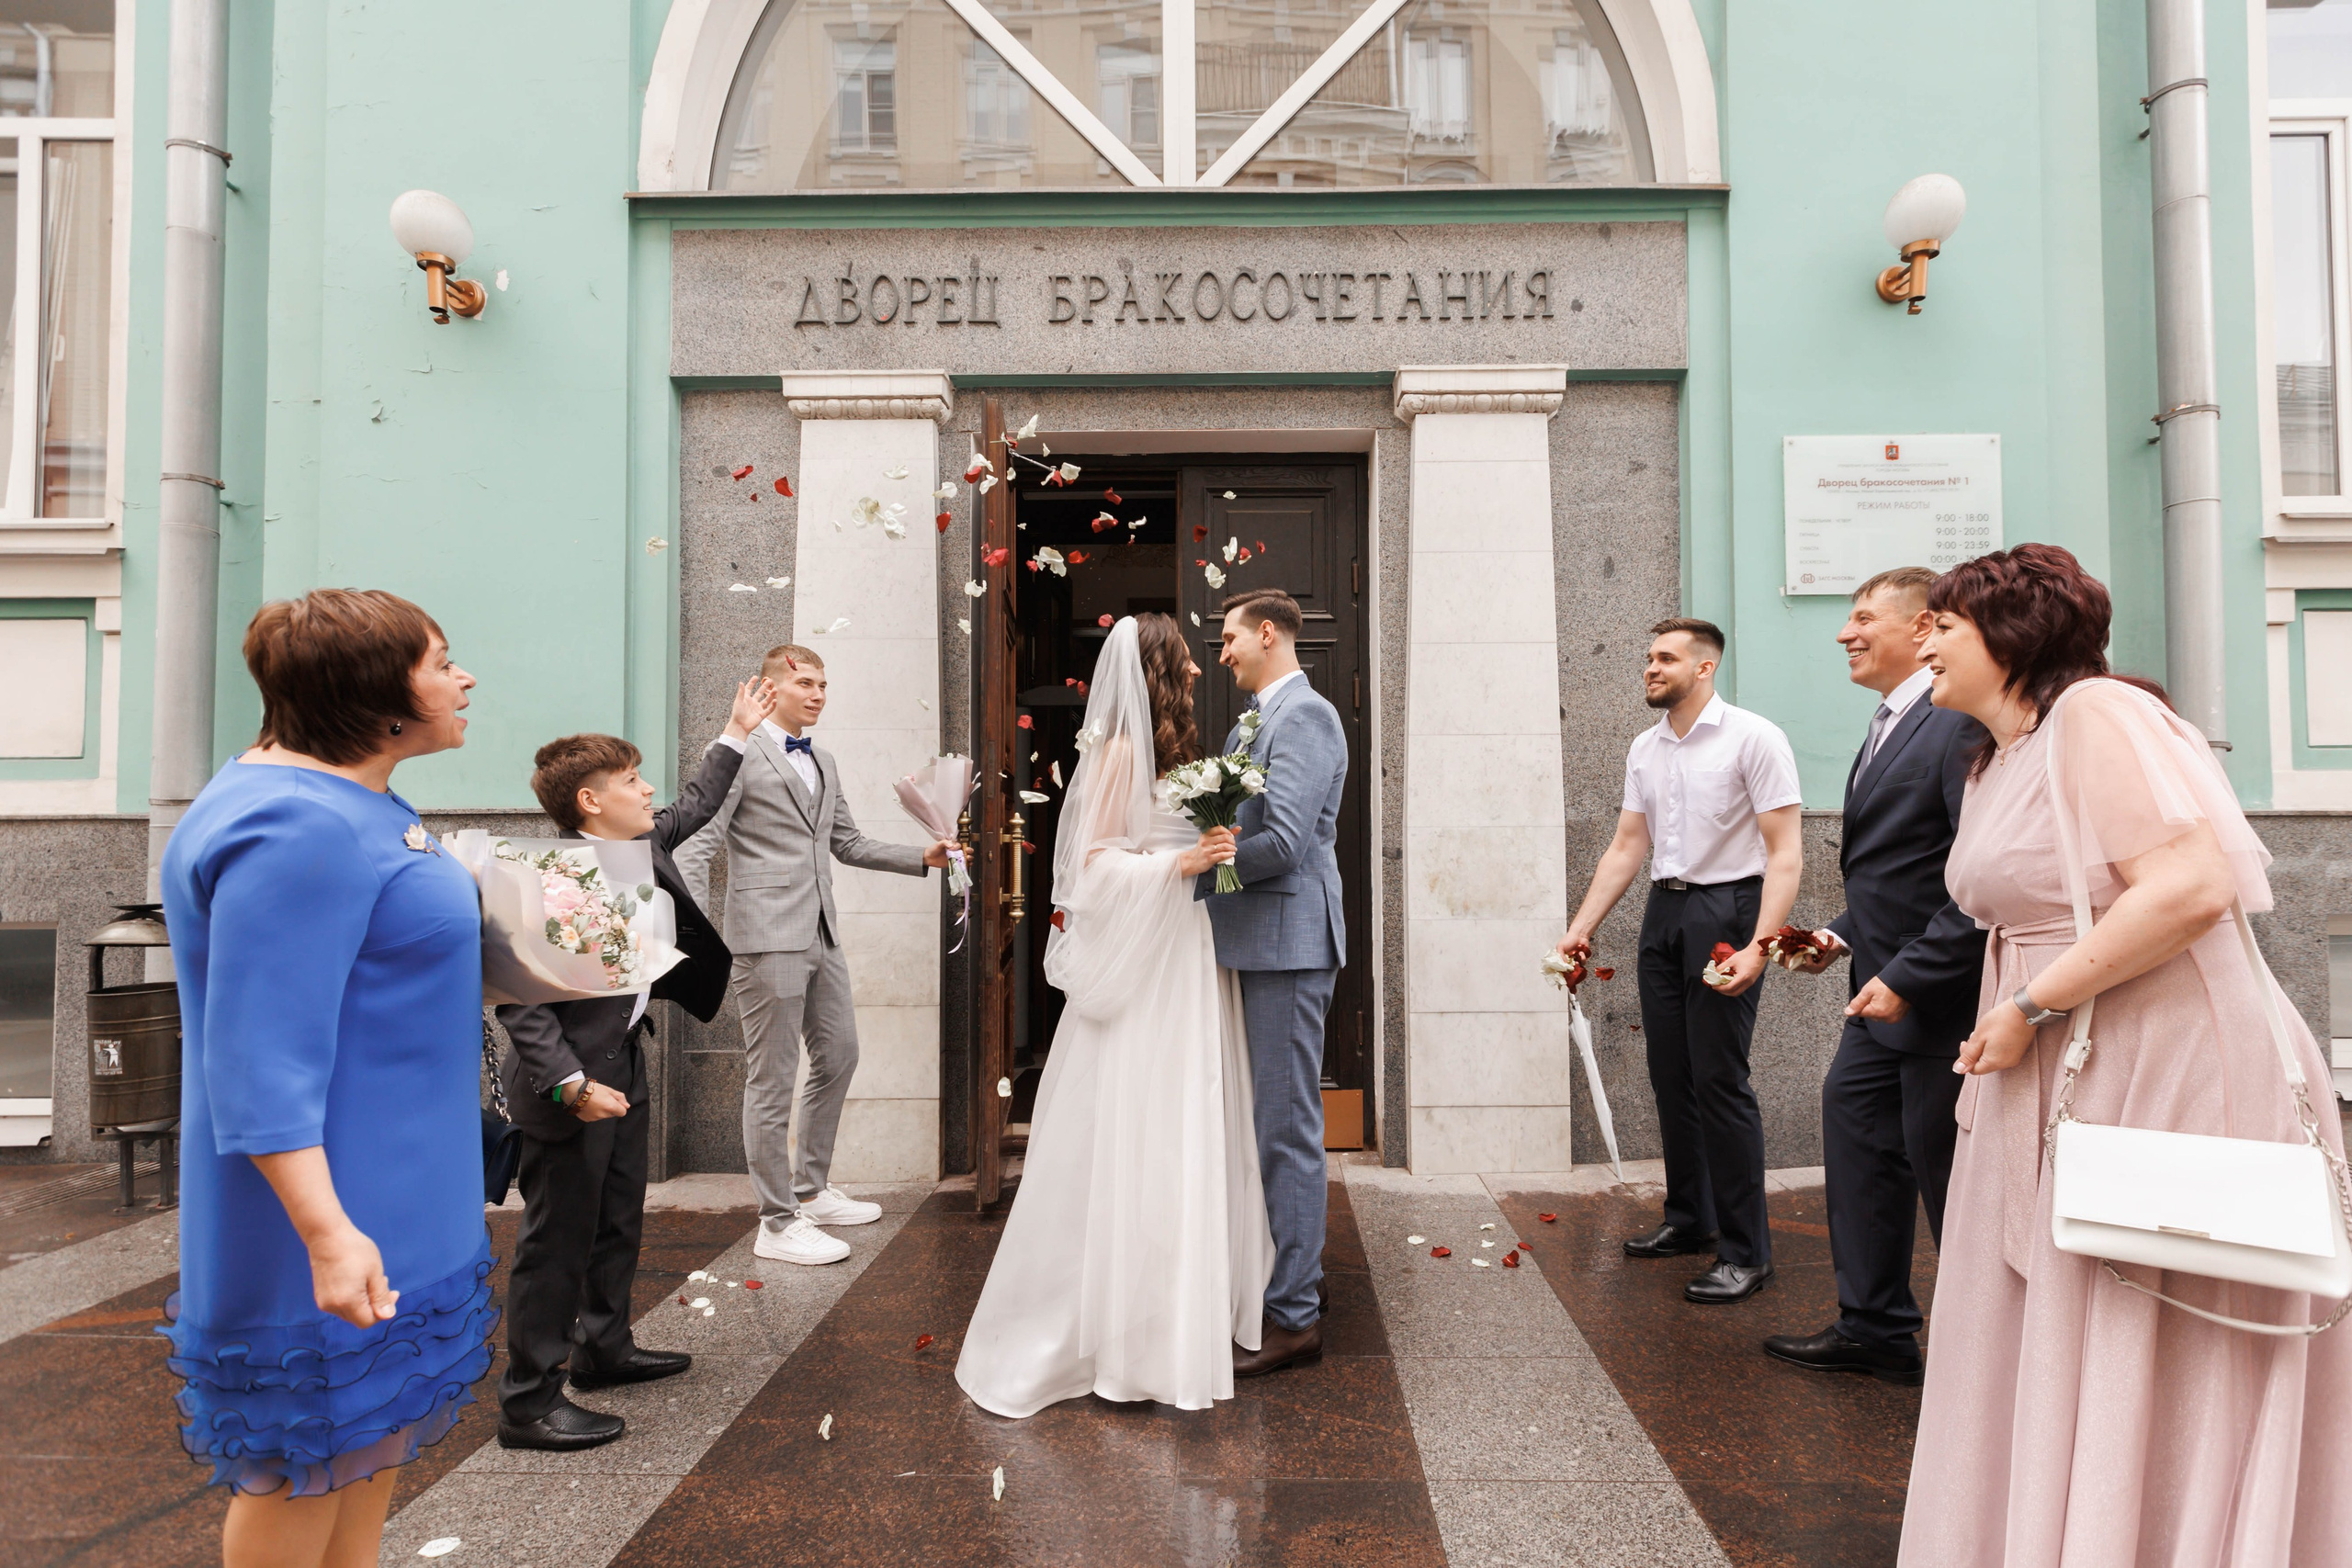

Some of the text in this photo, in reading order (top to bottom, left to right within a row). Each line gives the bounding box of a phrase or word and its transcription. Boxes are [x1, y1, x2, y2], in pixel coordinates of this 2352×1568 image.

[794, 270, 1555, 329] ДВОРЕЦ БРАКОСОЧЕТАНИЯ
[1817, 477, 1970, 489] Дворец бракосочетания № 1
[1857, 501, 1931, 510] РЕЖИМ РАБОТЫ
[1935, 513, 1956, 522] 9:00
[1965, 513, 1989, 522] 18:00
[1936, 527, 1957, 536] 9:00
[1963, 526, 1990, 536] 20:00
[1936, 541, 1957, 549] 9:00
[1964, 540, 1990, 549] 23:59
[1930, 555, 1957, 563] 00:00
